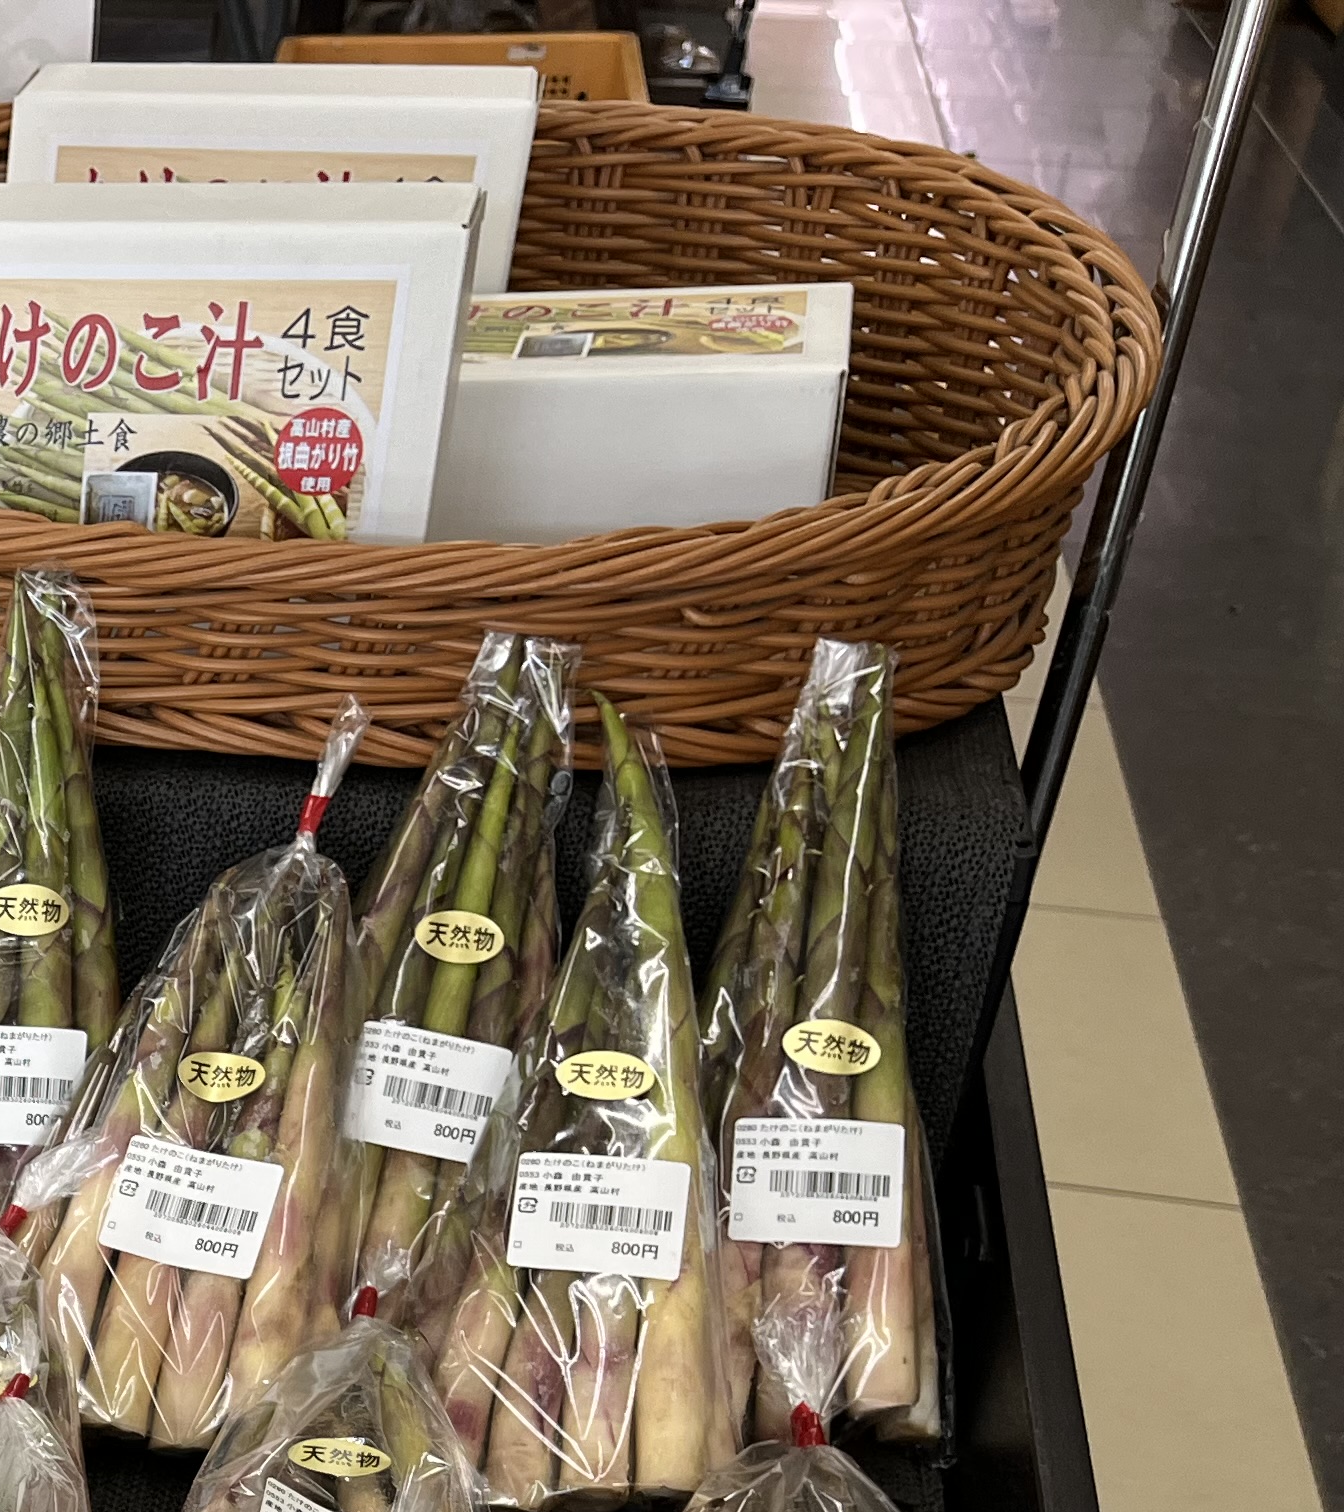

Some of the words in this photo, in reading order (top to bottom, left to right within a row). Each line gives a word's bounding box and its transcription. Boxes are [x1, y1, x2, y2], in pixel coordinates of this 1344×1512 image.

[281, 305, 366, 352] 4食
[275, 354, 363, 401] セット
[290, 417, 352, 438] 高山村産
[276, 442, 358, 472] 根曲がり竹
[299, 476, 331, 493] 使用
[426, 921, 495, 952] 天然物
[793, 1029, 871, 1066] 天然物
[187, 1060, 257, 1088] 天然物
[568, 1062, 645, 1089] 天然物
[433, 1123, 476, 1145] 800円
[833, 1210, 879, 1228] 800円
[194, 1238, 239, 1258] 800円
[611, 1241, 659, 1260] 800円
[301, 1445, 381, 1468] 天然物
